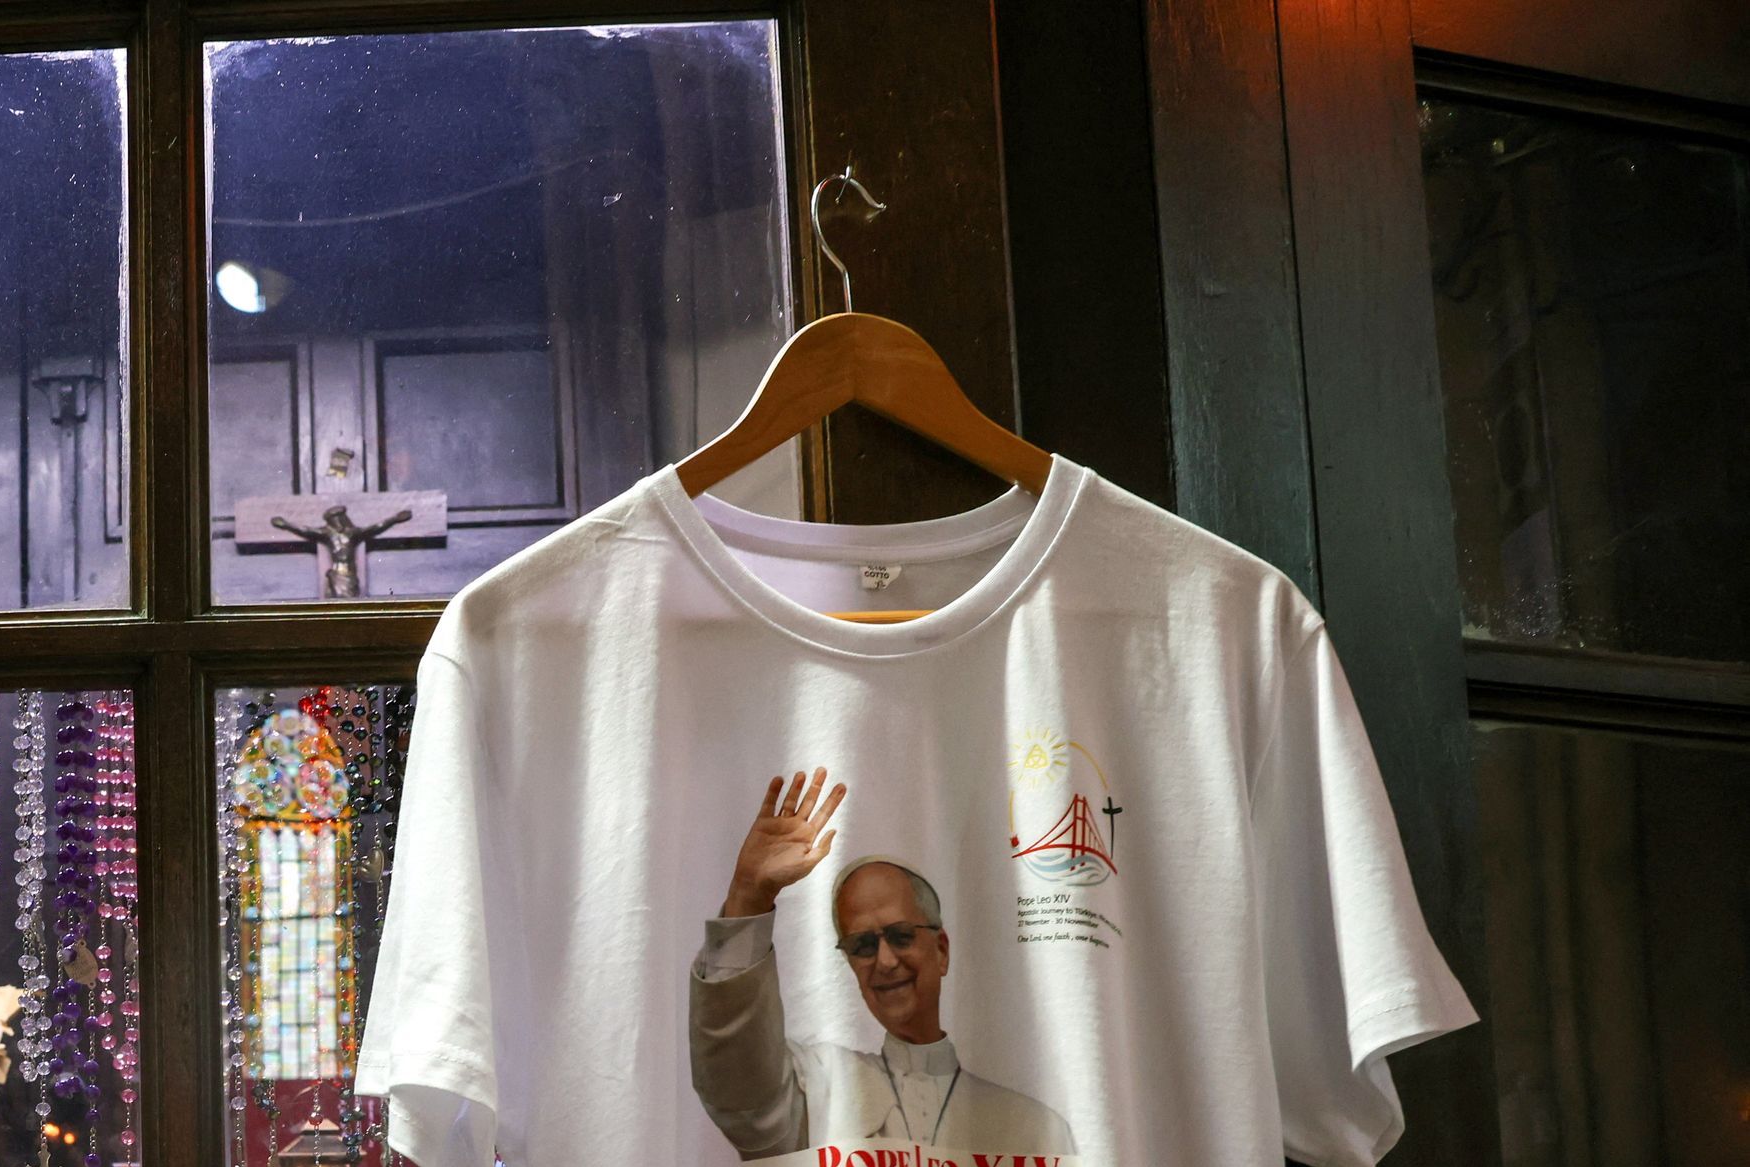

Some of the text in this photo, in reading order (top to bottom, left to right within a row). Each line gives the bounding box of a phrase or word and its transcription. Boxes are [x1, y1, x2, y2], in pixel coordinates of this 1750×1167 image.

[1017, 894, 1071, 906] Pope Leo XIV
